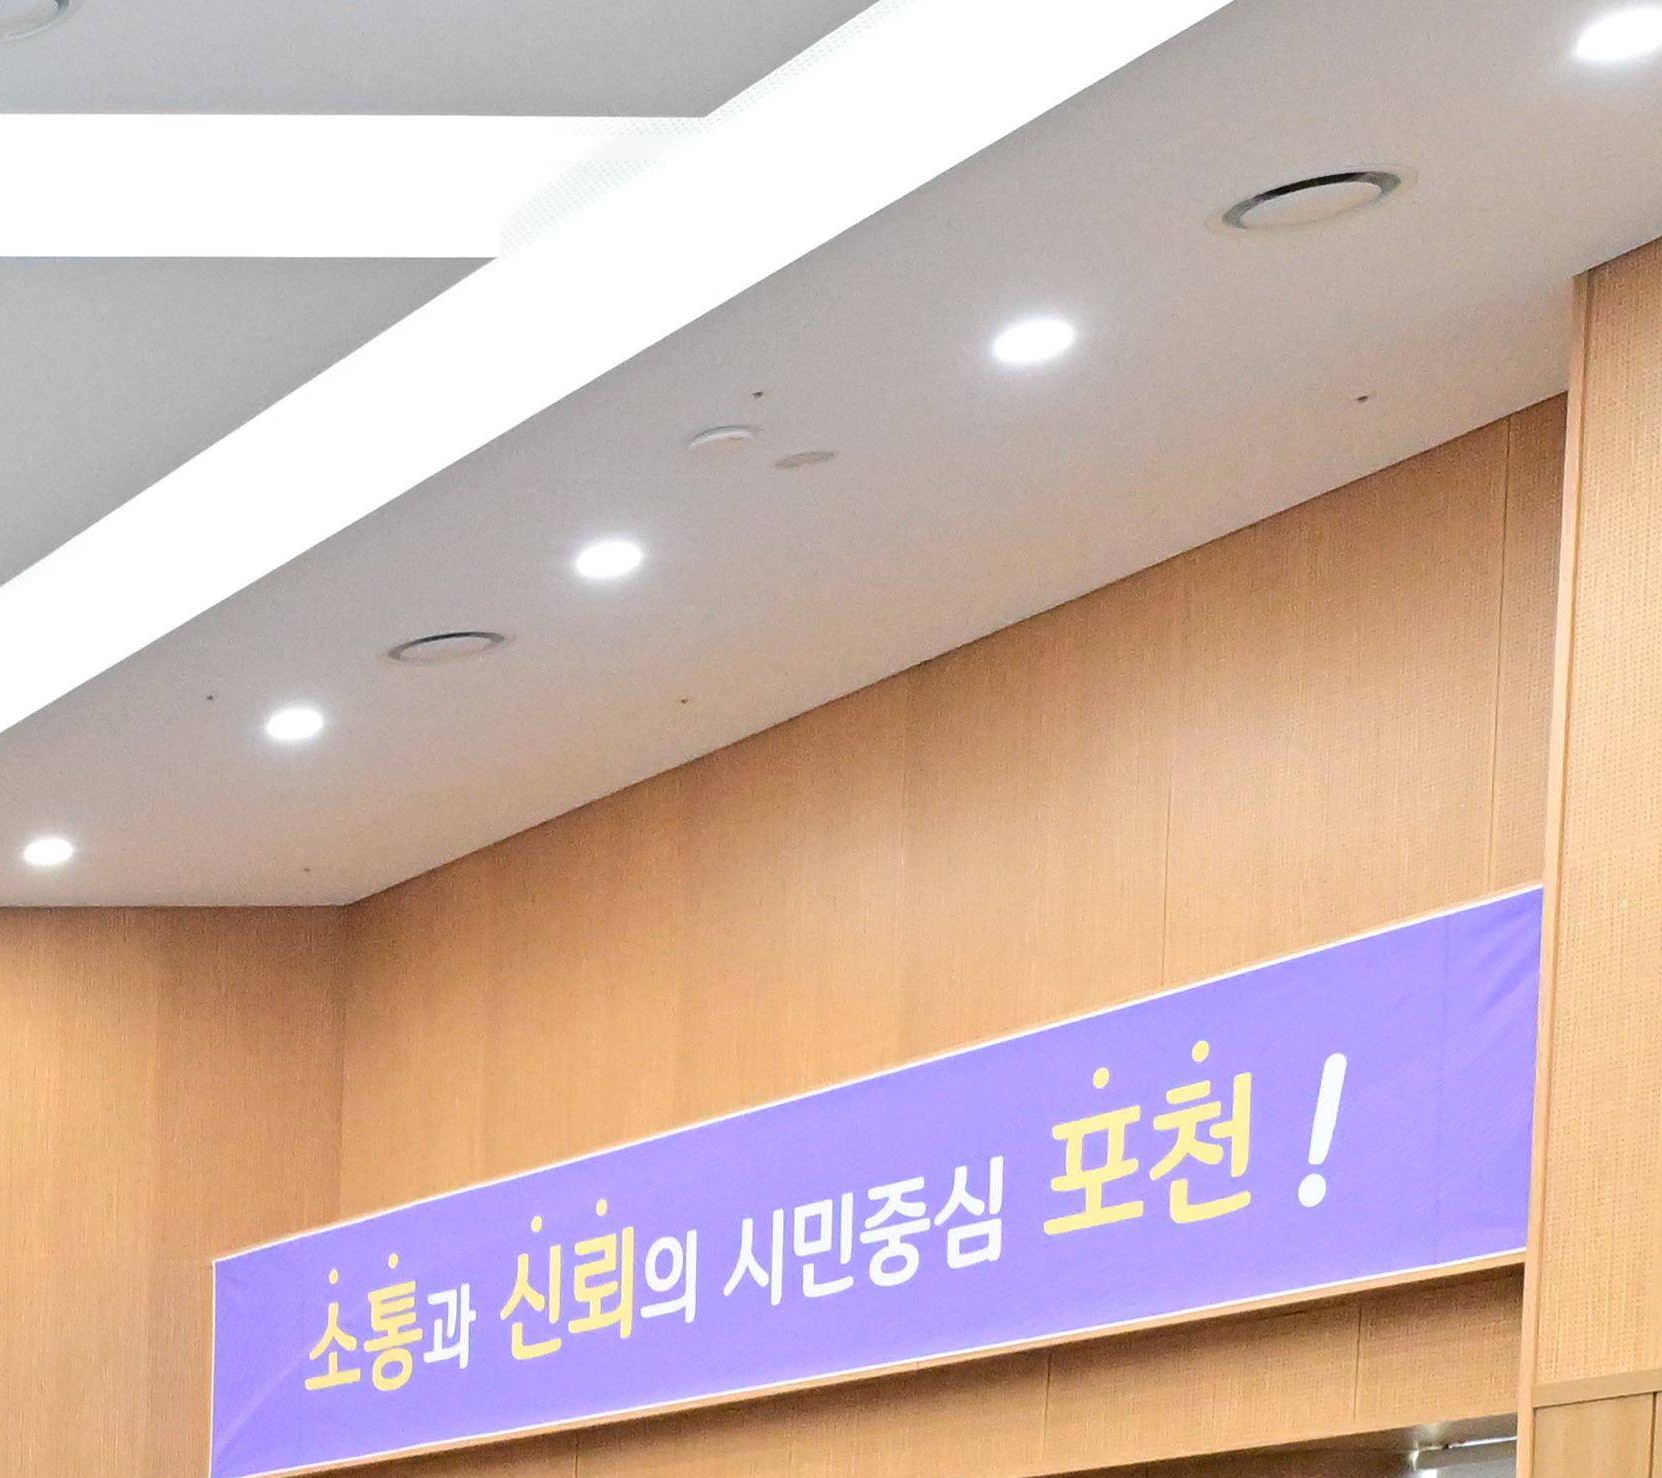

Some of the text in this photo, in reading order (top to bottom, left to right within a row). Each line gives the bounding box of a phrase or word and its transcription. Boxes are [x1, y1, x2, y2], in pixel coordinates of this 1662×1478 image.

[304, 1272, 477, 1396] 소통과
[499, 1218, 699, 1363] 신뢰의
[722, 1157, 1006, 1308] 시민중심
[1042, 1068, 1254, 1236] 포천
